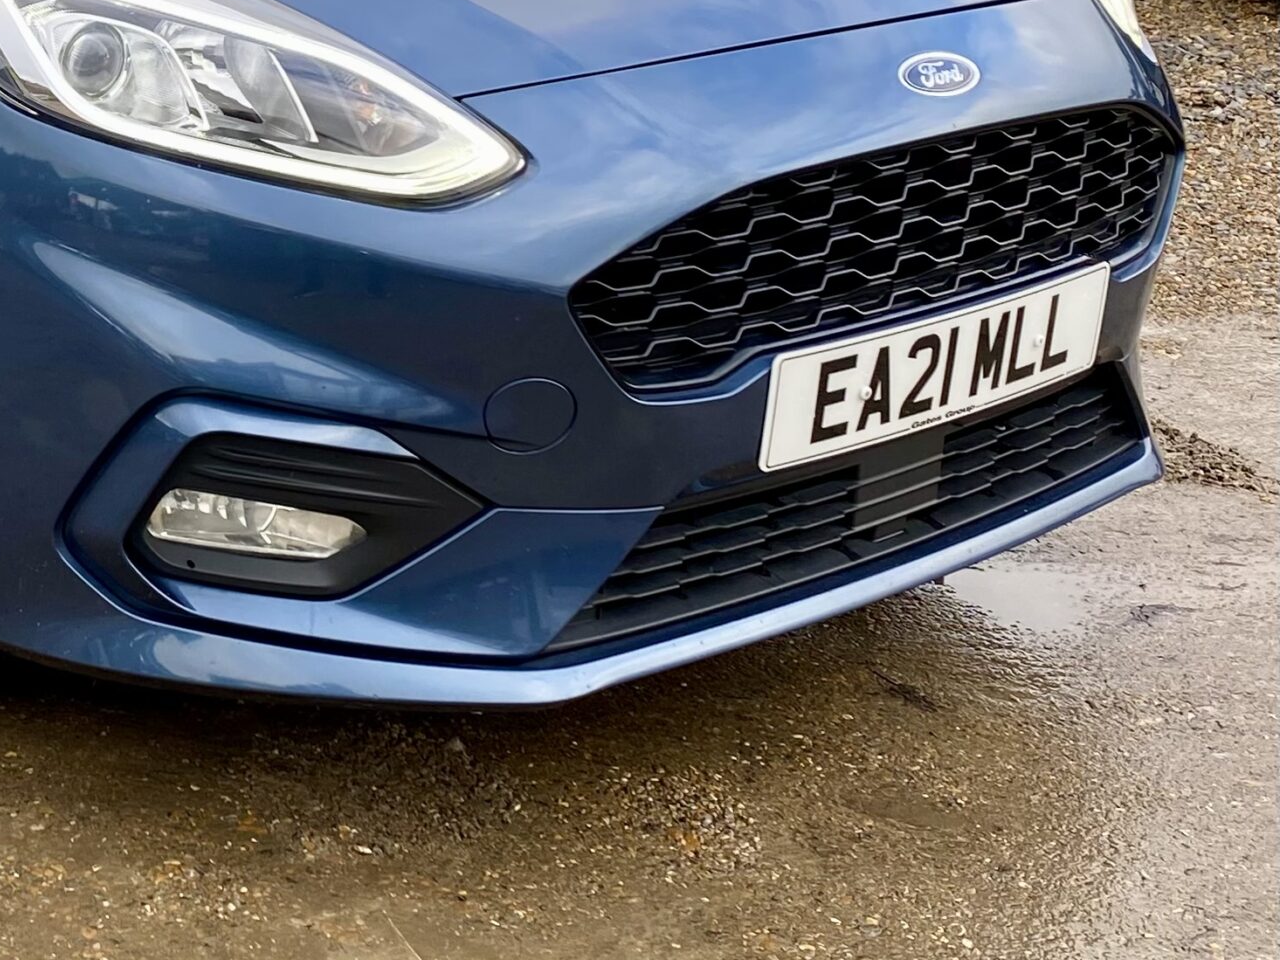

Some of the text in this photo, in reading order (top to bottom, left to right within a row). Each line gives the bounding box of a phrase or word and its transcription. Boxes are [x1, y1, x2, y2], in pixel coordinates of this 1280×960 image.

[918, 61, 964, 88] Ford
[810, 293, 1069, 444] EA21 MLL
[911, 404, 977, 430] Gates Group
